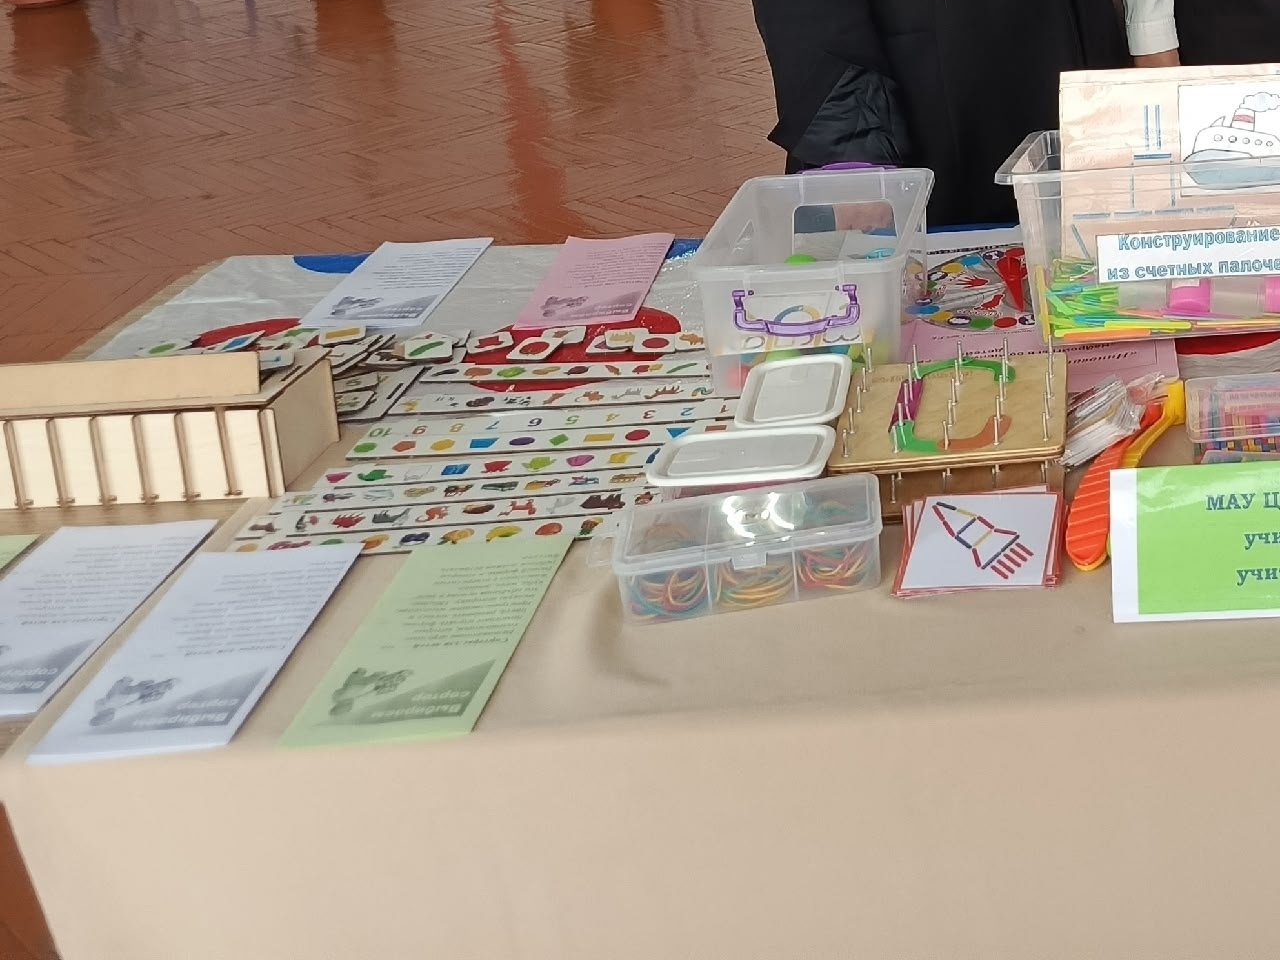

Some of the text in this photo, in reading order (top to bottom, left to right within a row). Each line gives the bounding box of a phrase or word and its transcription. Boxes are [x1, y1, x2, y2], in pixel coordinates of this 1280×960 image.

[1118, 227, 1280, 251] Конструирование
[1107, 268, 1130, 281] из
[1135, 262, 1213, 278] счетных
[1205, 493, 1256, 511] МАУ
